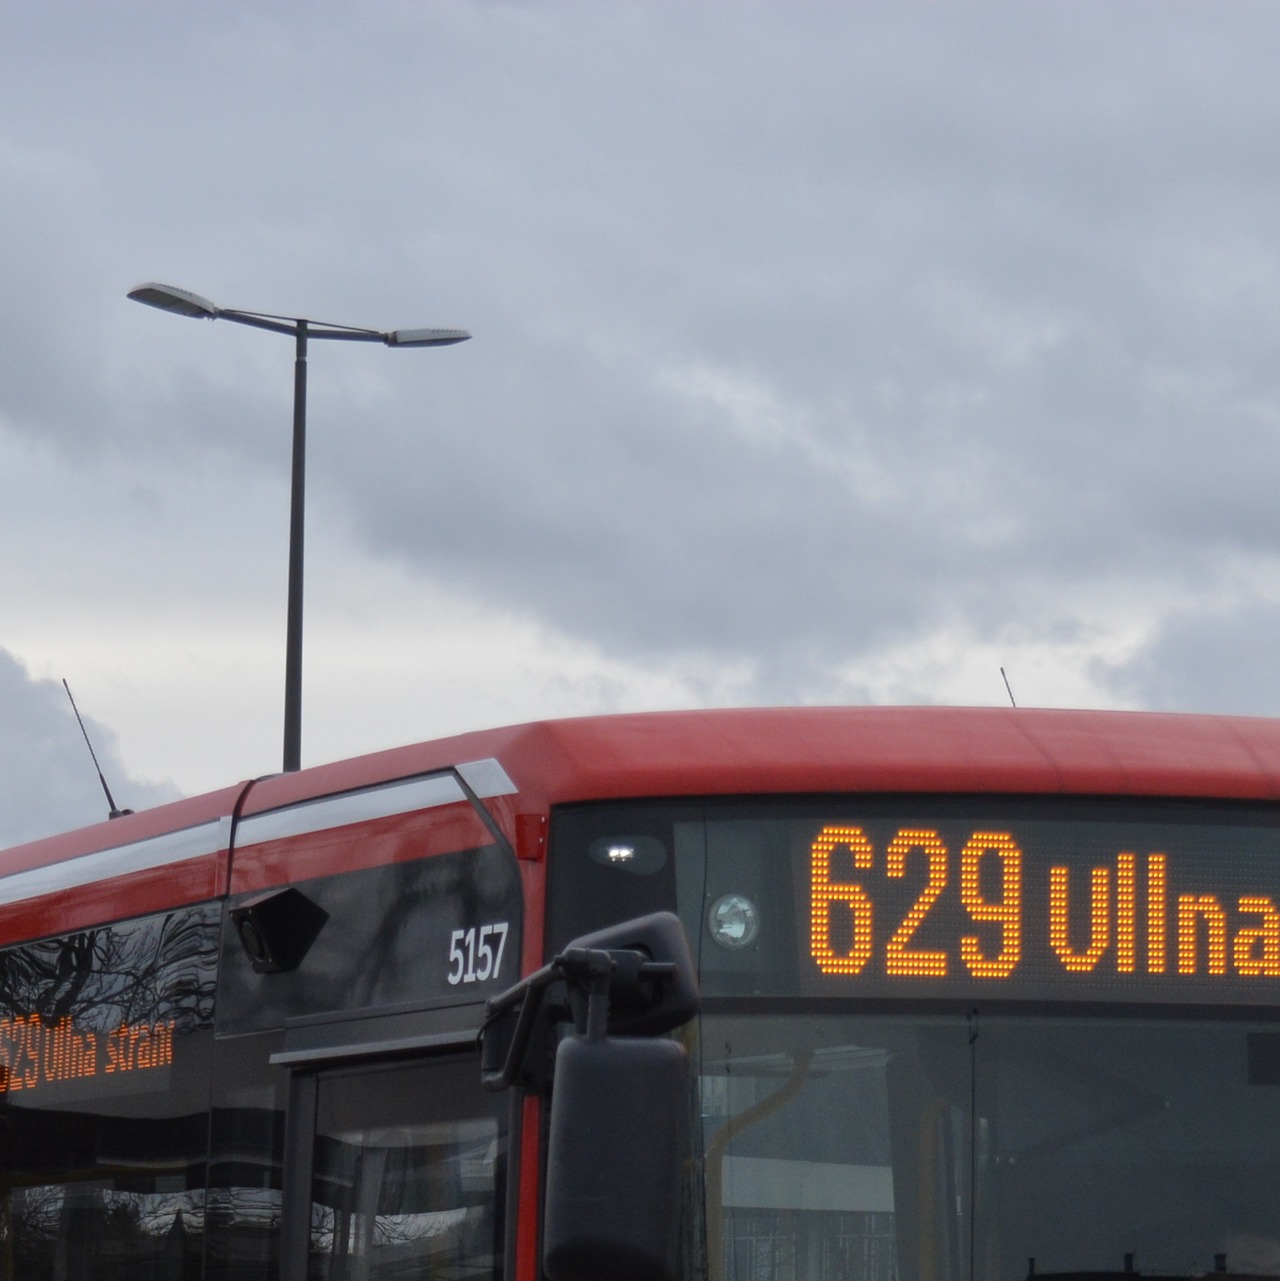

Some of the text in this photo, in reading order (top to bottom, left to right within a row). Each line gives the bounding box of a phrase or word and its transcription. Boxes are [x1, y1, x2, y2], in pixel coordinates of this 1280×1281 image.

[809, 826, 1023, 978] 629
[447, 922, 509, 985] 5157
[44, 1015, 97, 1082] Ullna
